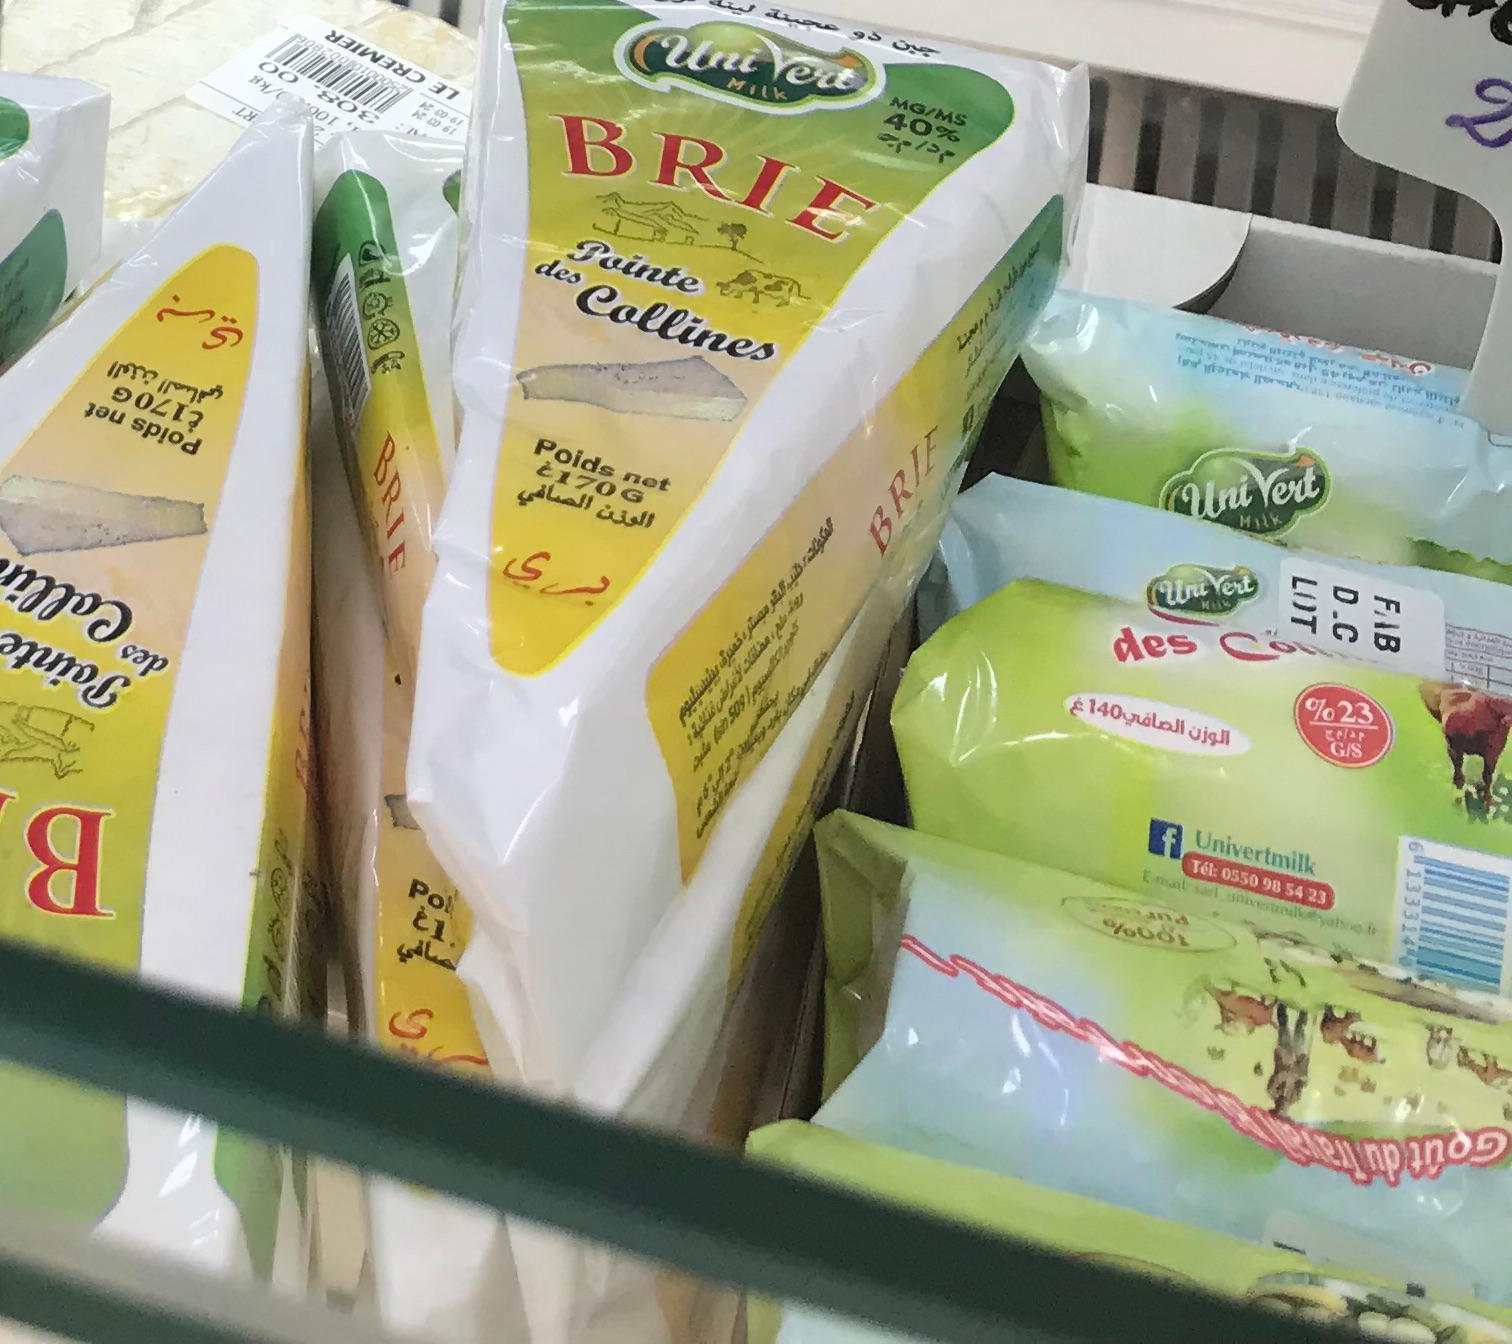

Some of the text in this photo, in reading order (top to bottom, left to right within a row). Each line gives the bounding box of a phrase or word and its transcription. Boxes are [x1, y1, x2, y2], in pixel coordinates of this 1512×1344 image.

[324, 28, 461, 101] LE CREMIER
[883, 112, 962, 144] 40%
[889, 96, 968, 128] MG/MS
[550, 111, 880, 245] BRIE
[567, 238, 706, 295] Pointe
[534, 258, 779, 363] des Collines
[83, 401, 204, 456] Poids net
[533, 437, 672, 494] Poids net
[867, 425, 940, 558] BRIE
[120, 642, 170, 678] des
[1113, 626, 1198, 663] des
[1330, 741, 1364, 759] G/S
[1195, 829, 1317, 875] Univertmilk
[1221, 867, 1259, 889] 0550
[1262, 877, 1282, 895] 98
[1285, 883, 1305, 900] 54
[1308, 888, 1328, 906] 23
